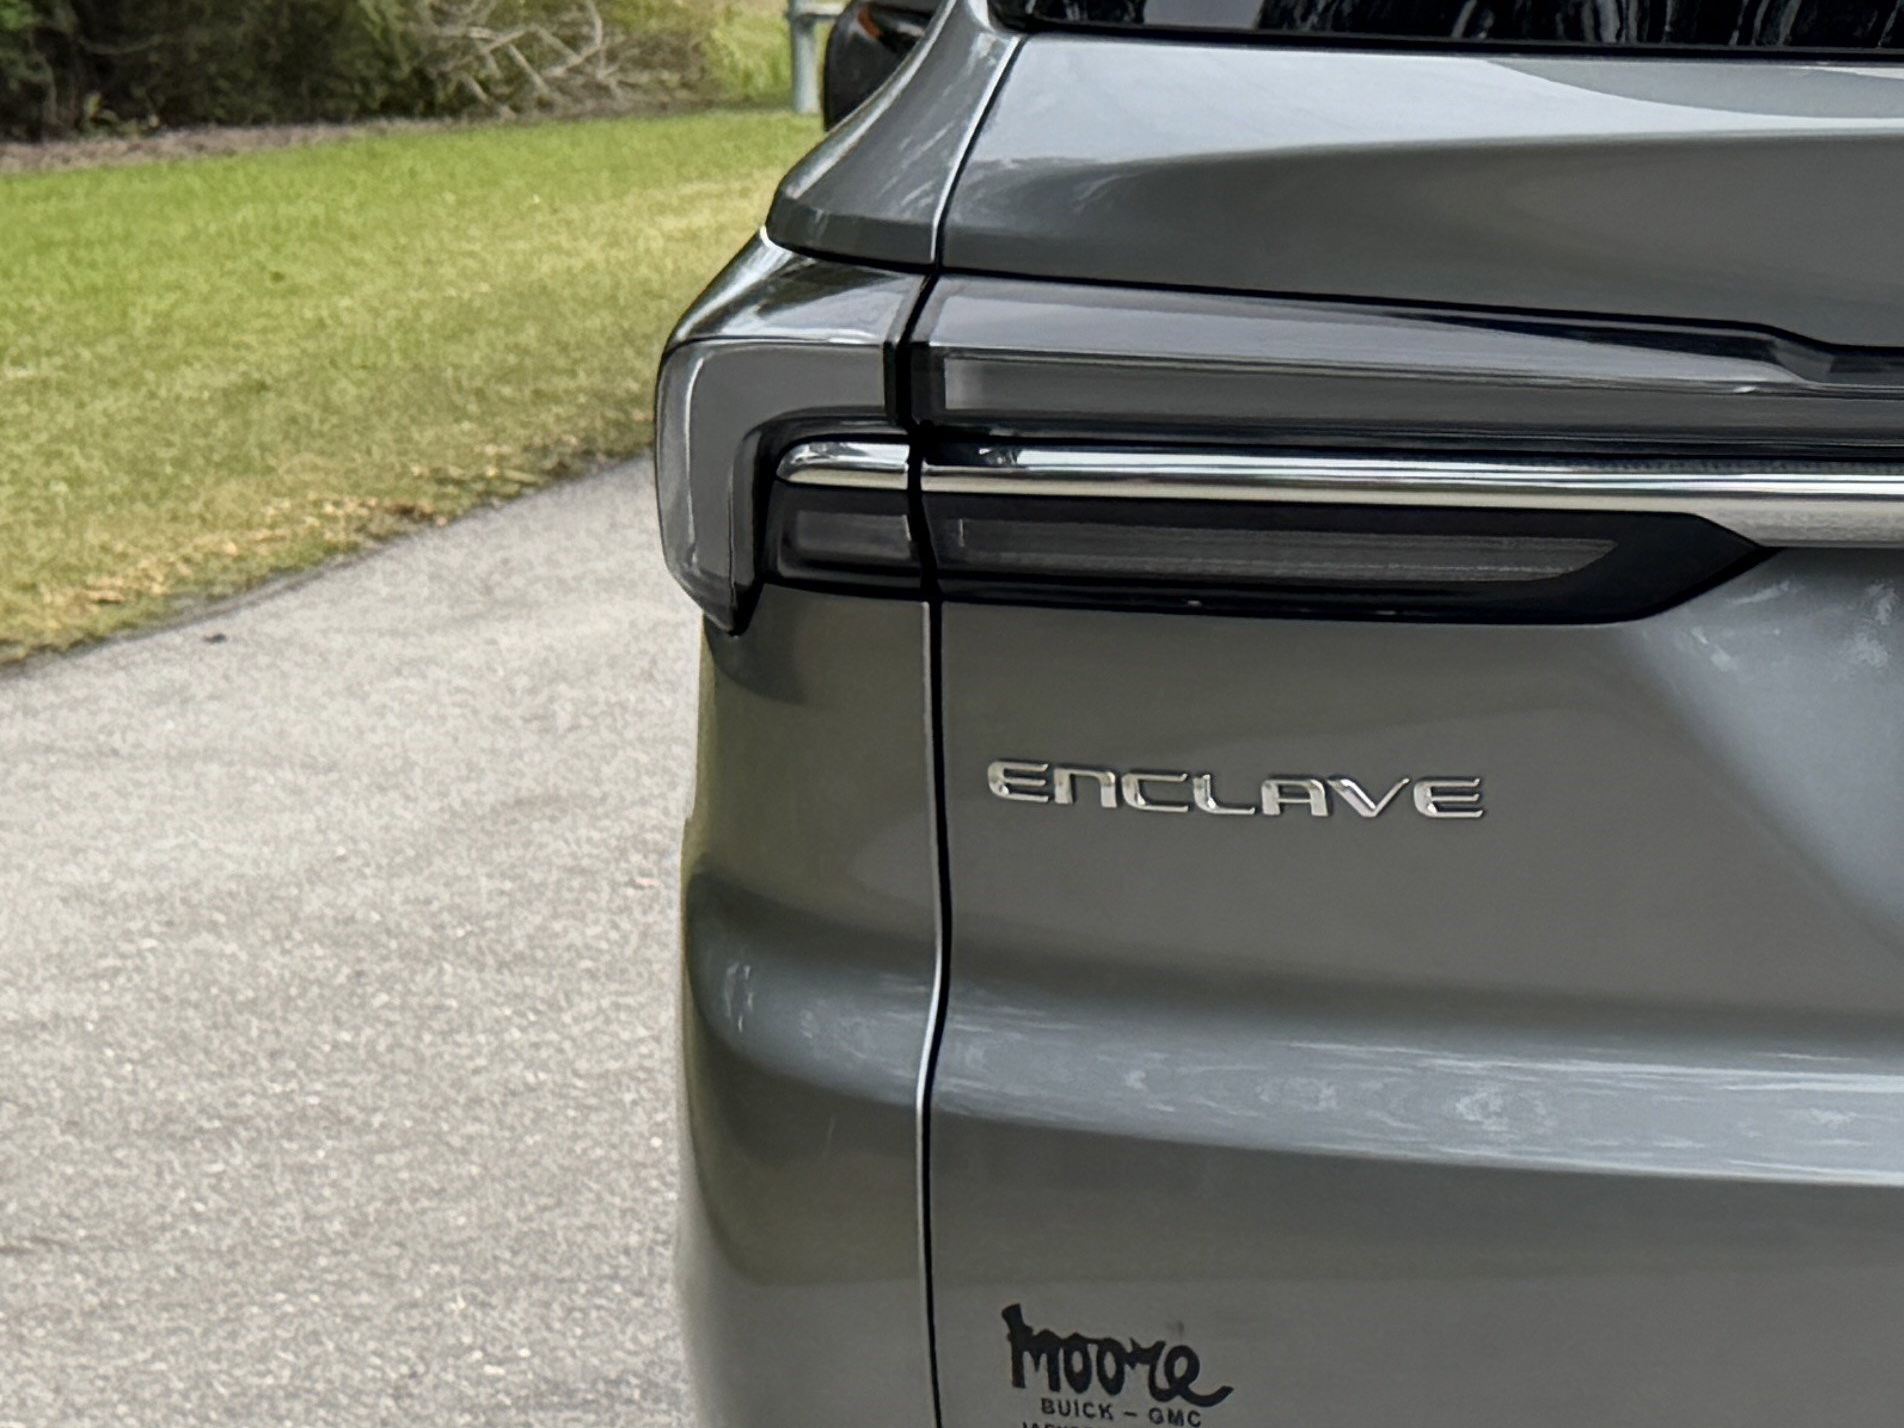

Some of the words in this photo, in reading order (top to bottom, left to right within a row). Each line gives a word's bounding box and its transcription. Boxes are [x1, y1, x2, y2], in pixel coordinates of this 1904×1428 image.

[987, 760, 1484, 818] ENCLAVE
[1041, 1397, 1114, 1421] BUICK
[1148, 1407, 1203, 1428] GMC
